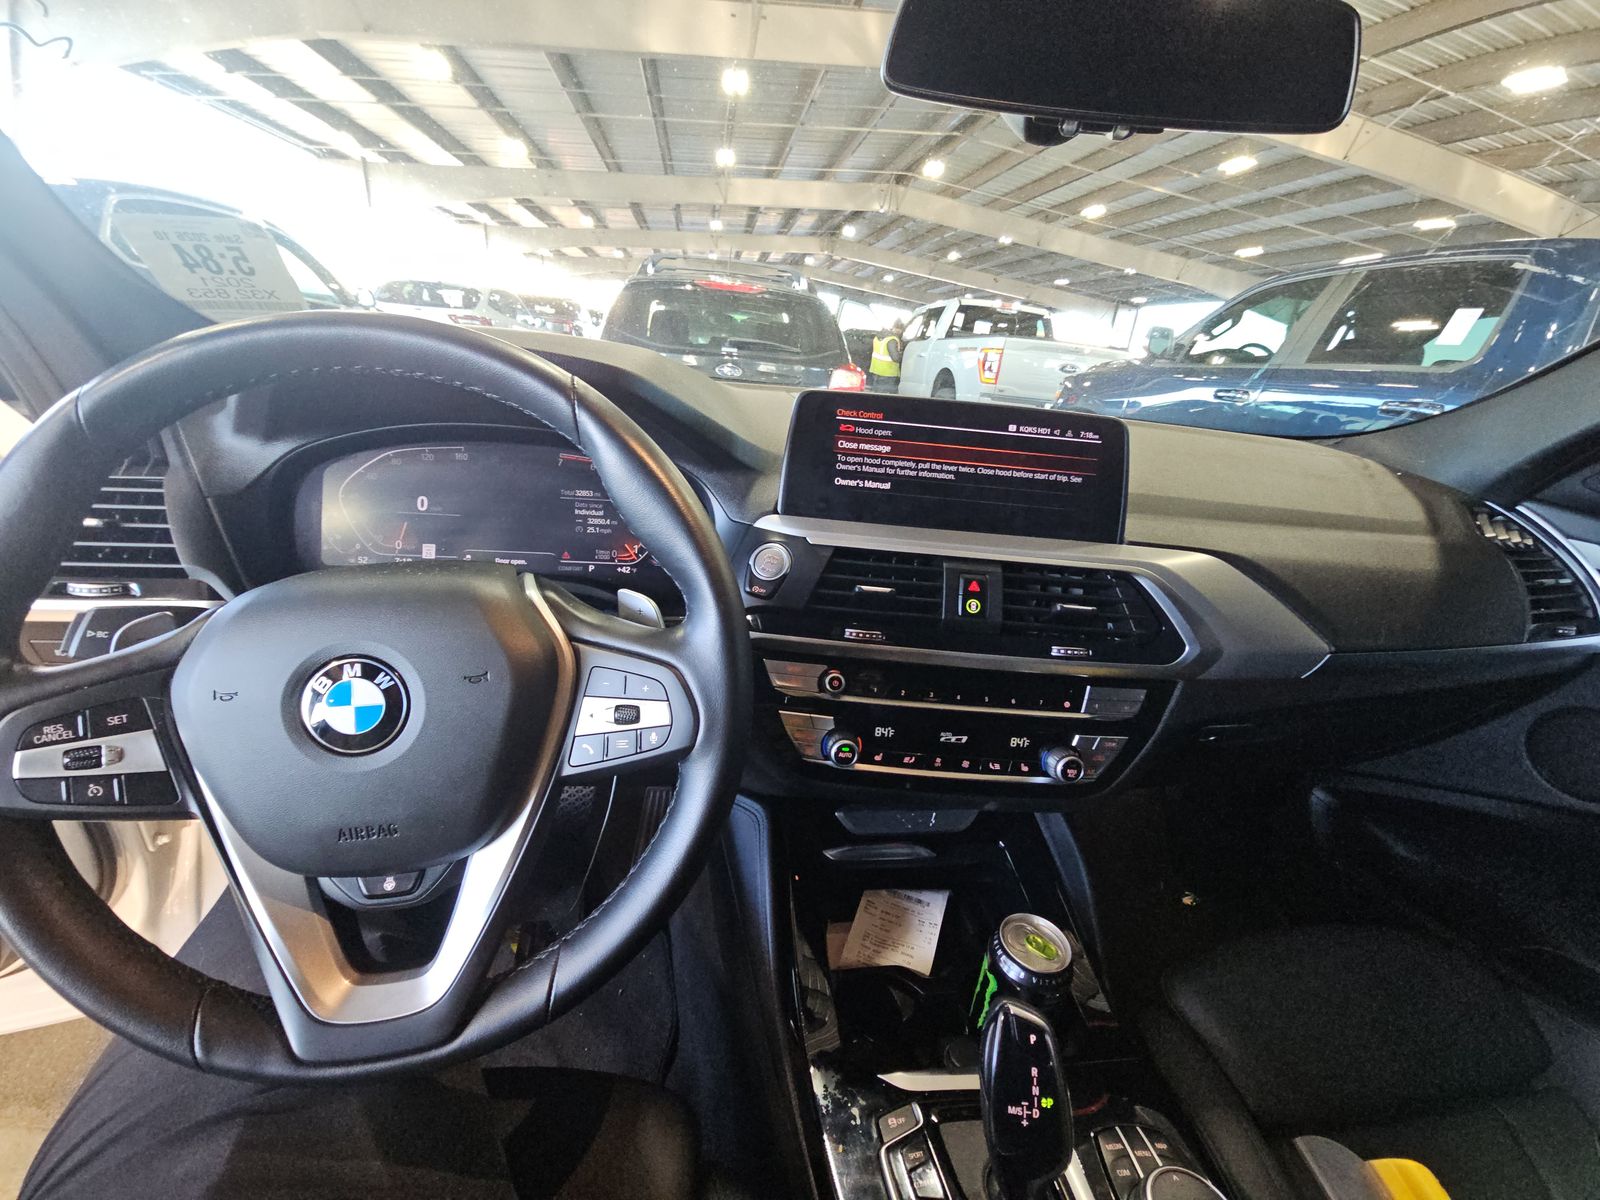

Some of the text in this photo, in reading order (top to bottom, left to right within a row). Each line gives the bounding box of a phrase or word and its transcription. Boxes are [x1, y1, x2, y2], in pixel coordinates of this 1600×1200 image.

[837, 409, 883, 419] Check Control
[838, 440, 891, 452] Close message
[836, 463, 861, 471] Owner's
[862, 465, 885, 473] Manual
[897, 468, 917, 476] further
[919, 470, 955, 479] information.
[847, 456, 863, 464] open
[1013, 470, 1033, 478] before
[1034, 472, 1048, 480] start
[1057, 474, 1069, 482] trip.
[835, 478, 891, 489] Owner's Manual
[417, 496, 428, 511] 0
[96, 630, 109, 639] BC
[312, 663, 395, 695] BMW
[106, 714, 128, 726] SET
[43, 724, 64, 734] RES
[34, 730, 76, 744] CANCEL
[338, 824, 400, 842] AIRBAG
[1030, 1034, 1036, 1044] P
[1031, 1067, 1038, 1077] R
[1032, 1086, 1039, 1095] N
[1008, 1106, 1022, 1116] M/S
[1032, 1108, 1040, 1118] D
[909, 1151, 923, 1160] SPORT
[1116, 1169, 1131, 1177] COM
